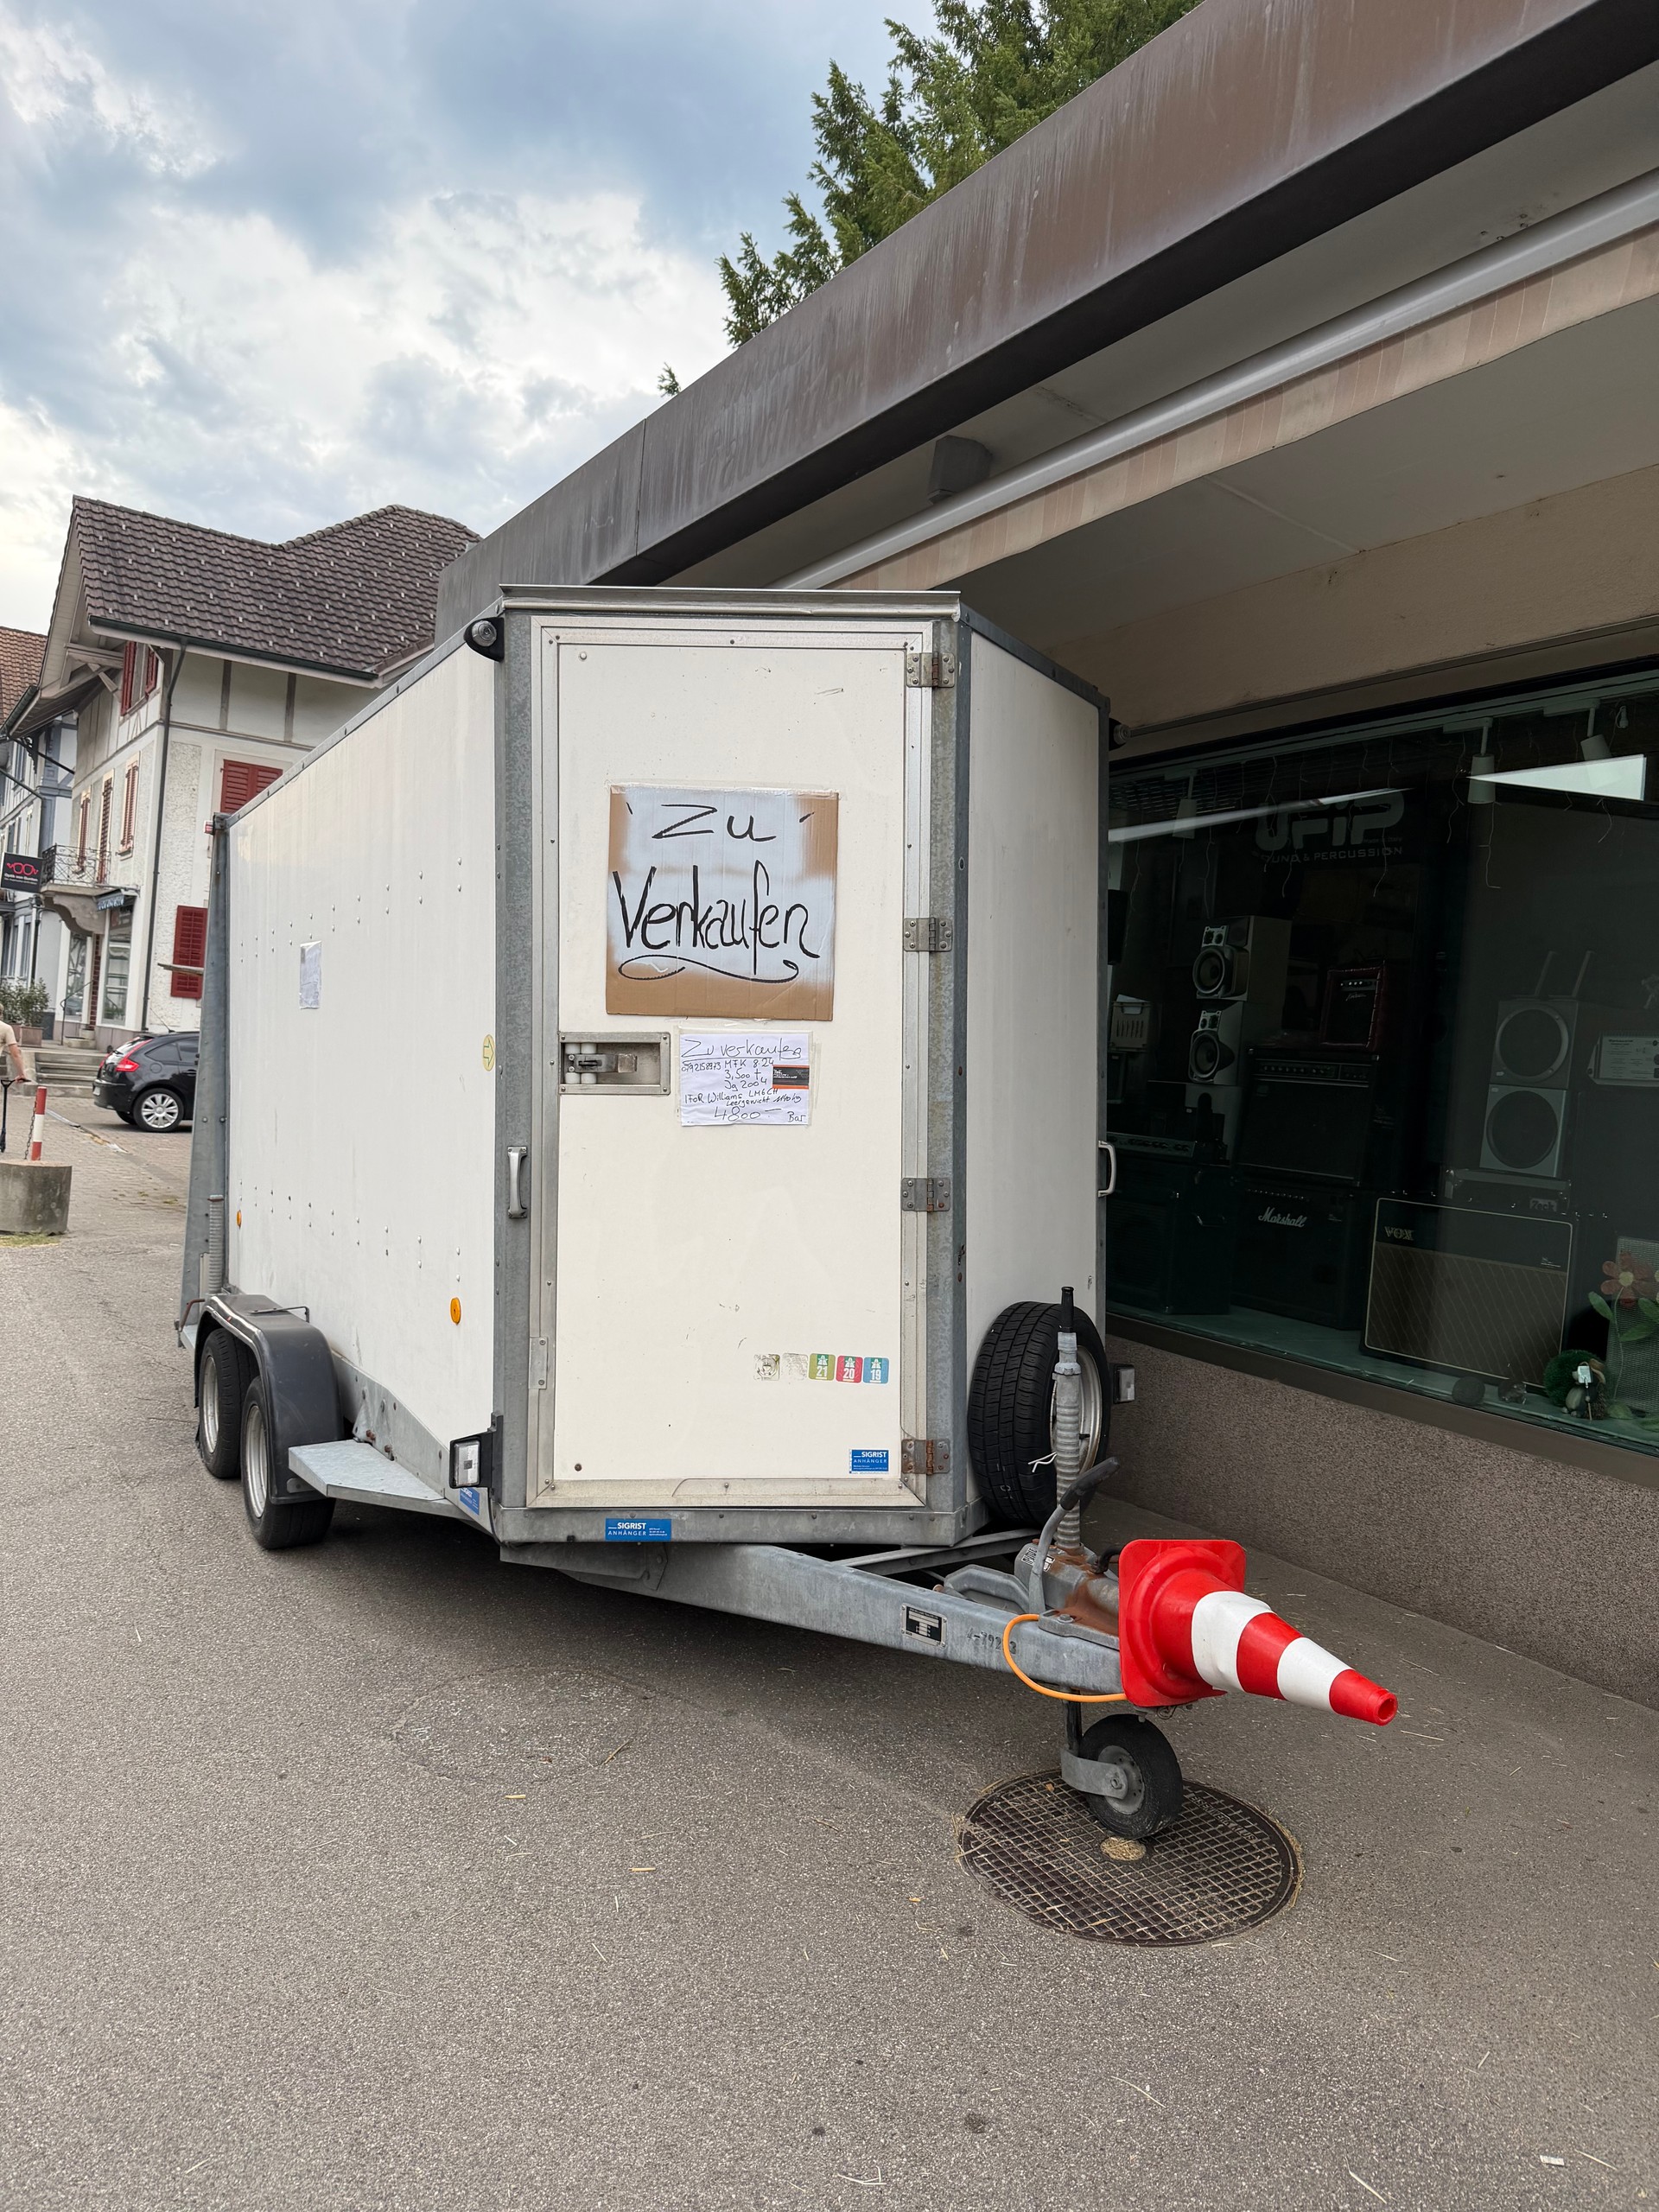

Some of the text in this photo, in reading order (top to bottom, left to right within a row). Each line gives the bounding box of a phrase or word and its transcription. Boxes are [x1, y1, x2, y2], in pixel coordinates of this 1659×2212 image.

[652, 803, 777, 842] Zu
[1314, 846, 1402, 861] PERCUSSION
[612, 860, 820, 976] Verkaufen
[741, 1077, 767, 1089] 2004
[786, 1110, 807, 1122] Bar
[1257, 1206, 1307, 1228] Marshall
[1384, 1225, 1414, 1242] VOX
[816, 1365, 828, 1378] 21
[842, 1368, 855, 1380] 20
[870, 1370, 881, 1381] 19
